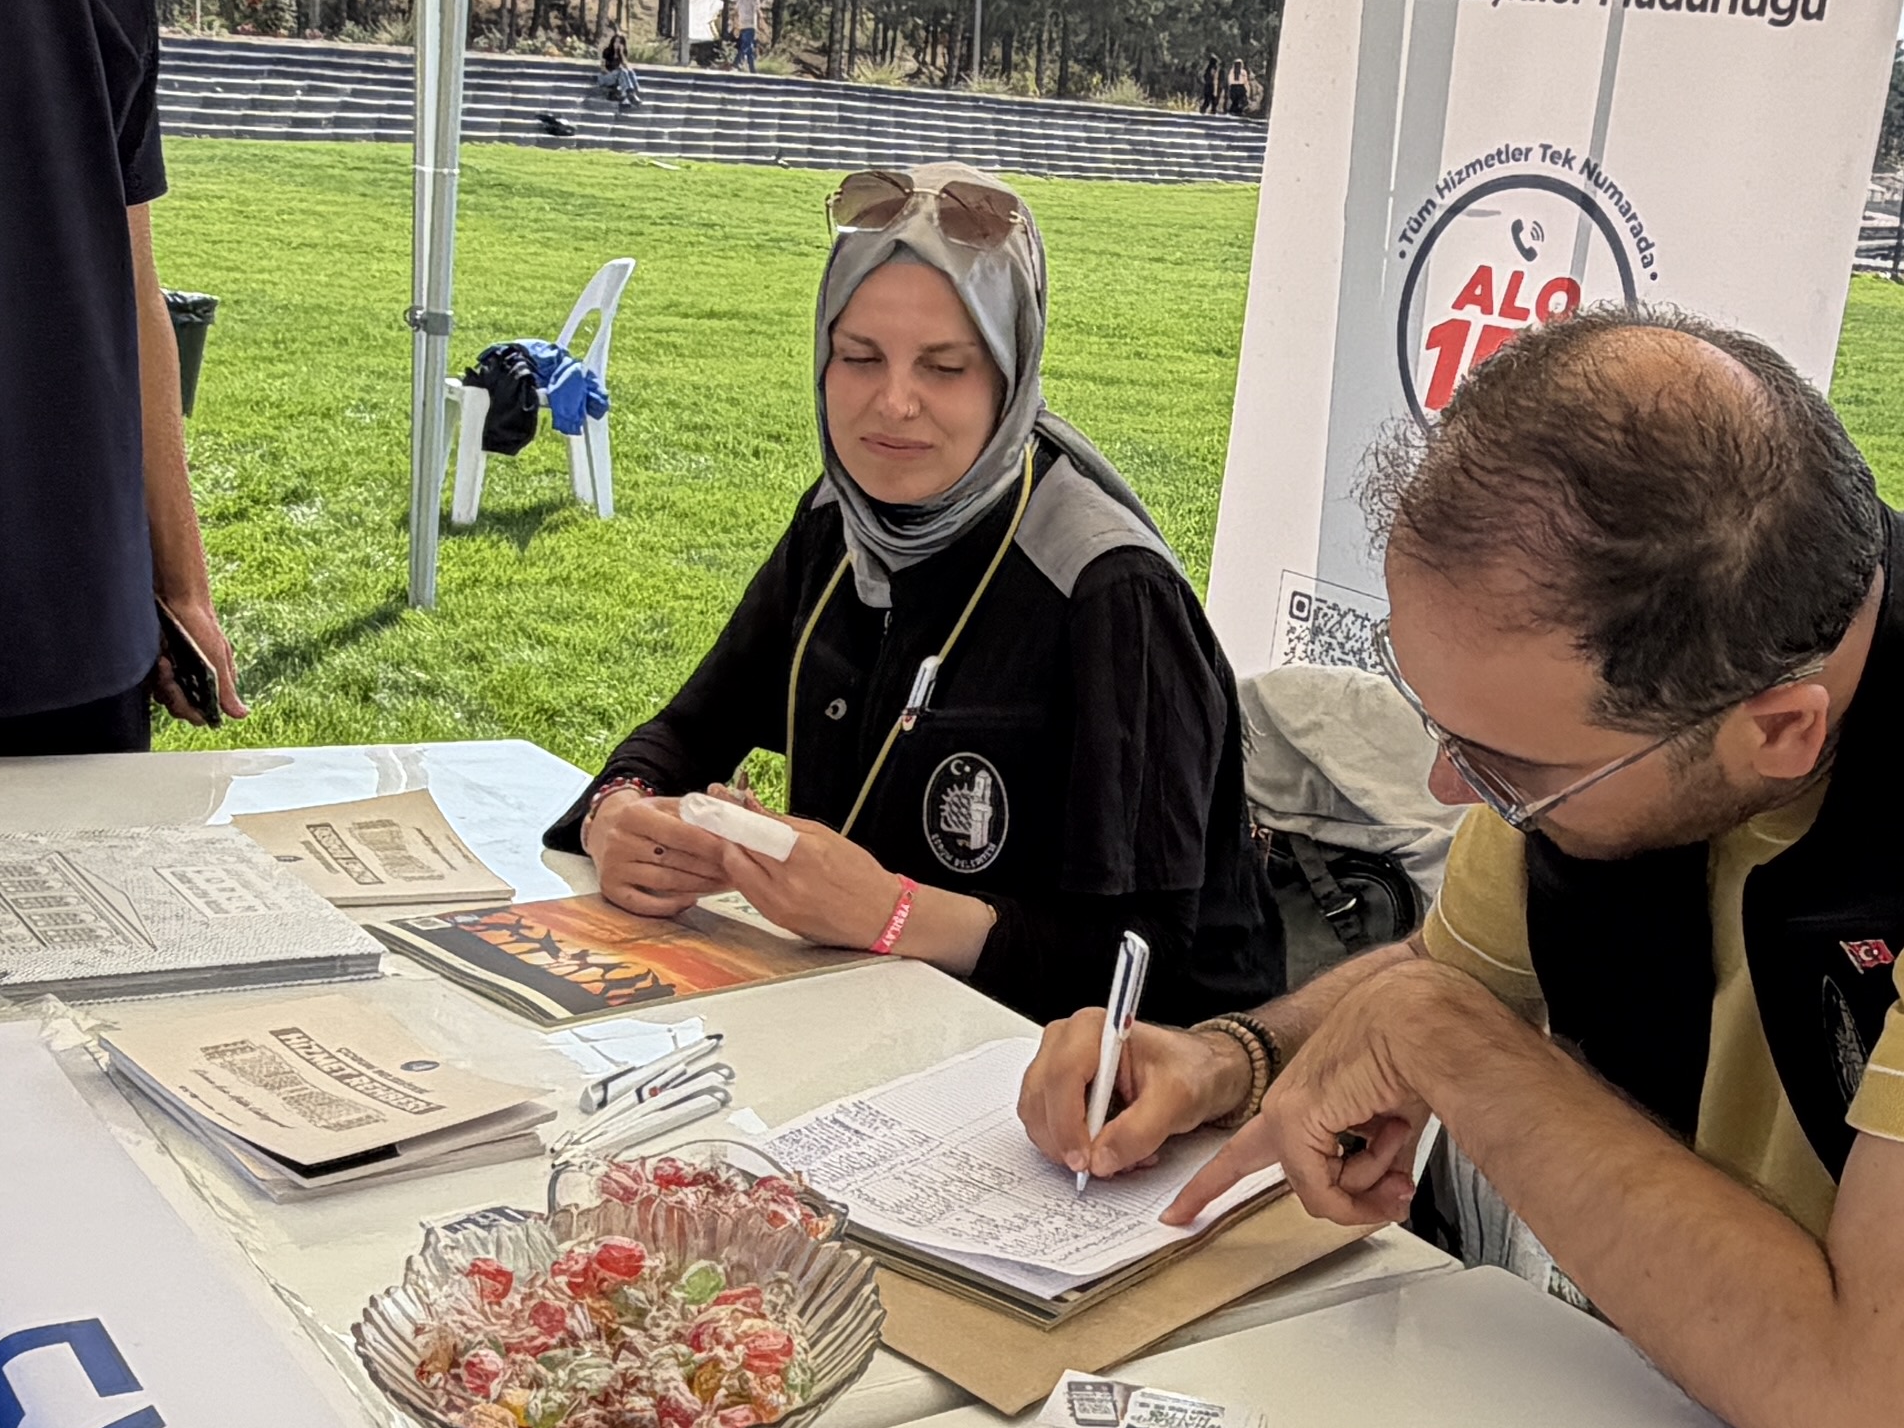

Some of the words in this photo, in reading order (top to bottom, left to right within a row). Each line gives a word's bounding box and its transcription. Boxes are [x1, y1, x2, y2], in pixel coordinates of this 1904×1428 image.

[1399, 200, 1438, 247] Tüm
[1437, 143, 1533, 204] Hizmetler
[1539, 143, 1577, 169] Tek
[1577, 157, 1656, 270] Numarada
[1452, 265, 1582, 322] ALO
